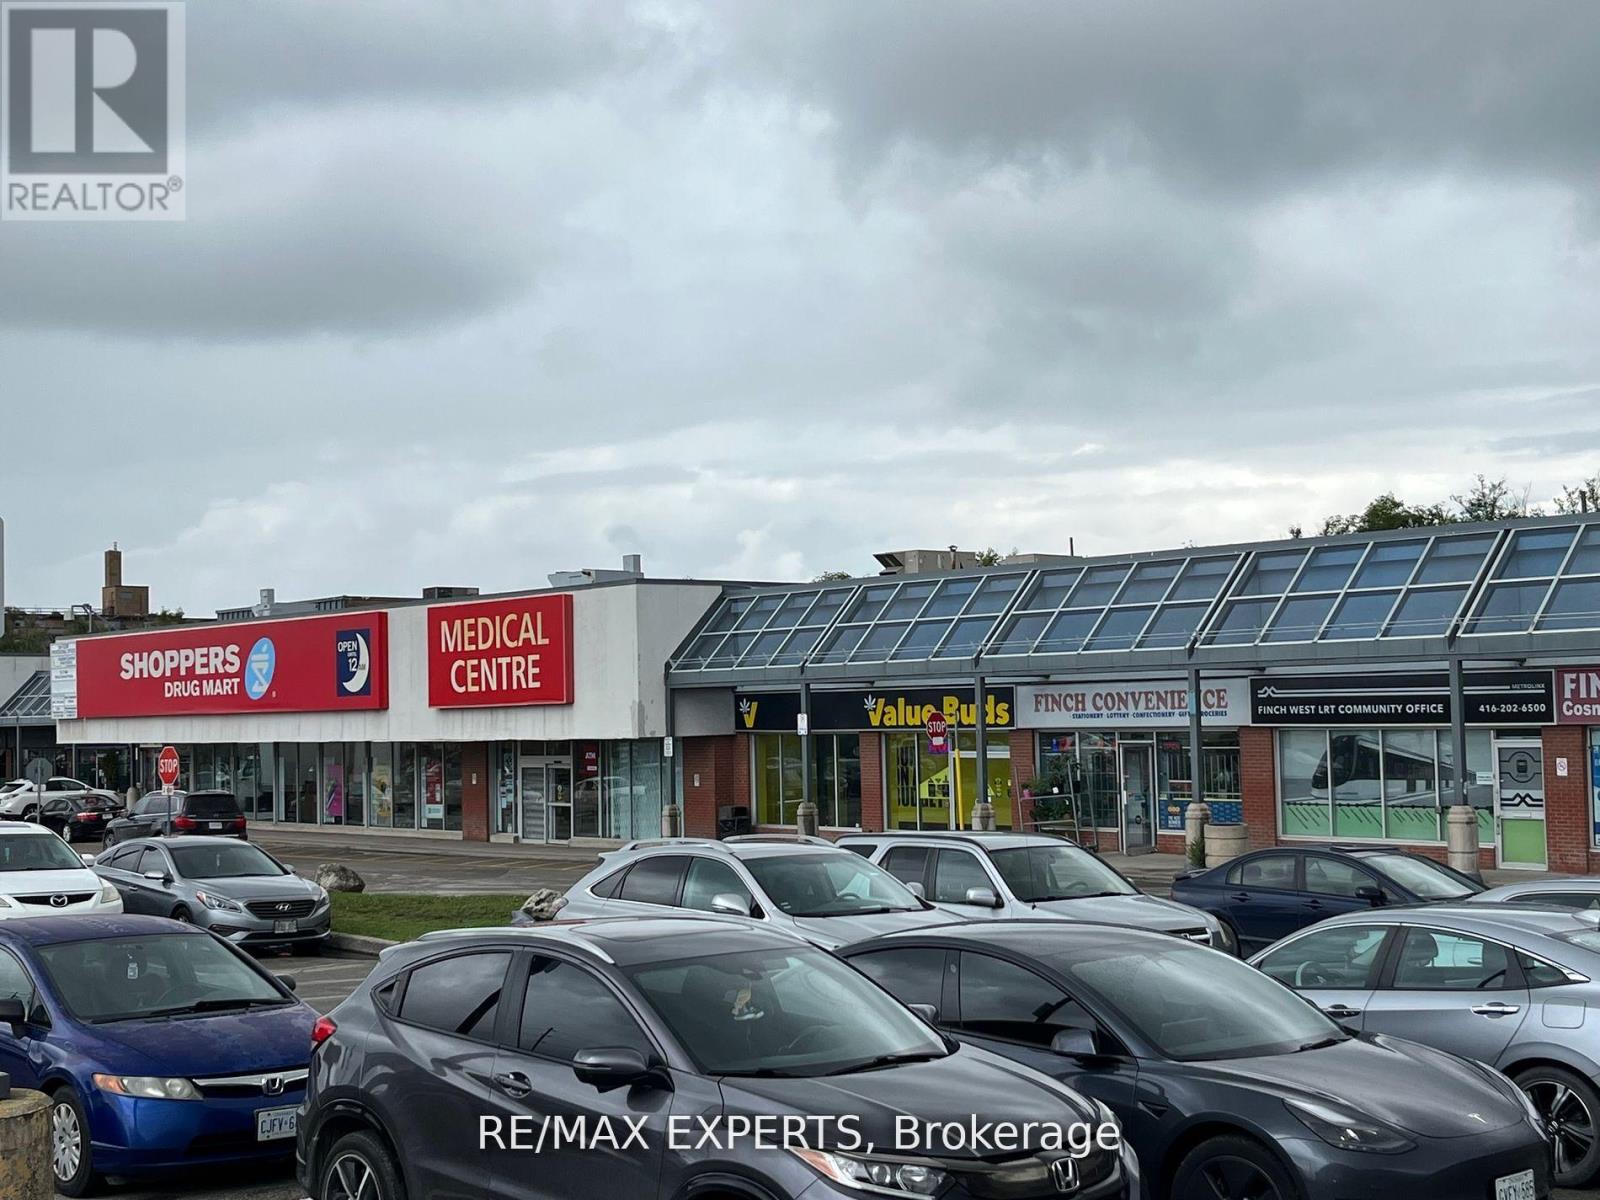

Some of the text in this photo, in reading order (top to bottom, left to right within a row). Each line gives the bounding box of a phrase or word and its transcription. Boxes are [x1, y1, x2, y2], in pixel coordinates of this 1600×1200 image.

[440, 611, 549, 653] MEDICAL
[338, 641, 357, 652] OPEN
[120, 644, 241, 680] SHOPPERS
[348, 658, 357, 672] 12
[450, 654, 541, 694] CENTRE
[164, 678, 241, 698] DRUG MART
[1033, 688, 1229, 712] FINCH CONVENIECE
[1479, 703, 1546, 713] 416-202-6500
[869, 698, 935, 727] Value
[1257, 704, 1444, 715] FINCH WEST LRT COMMUNITY OFFICE
[927, 721, 946, 733] STOP
[159, 758, 178, 774] STOP
